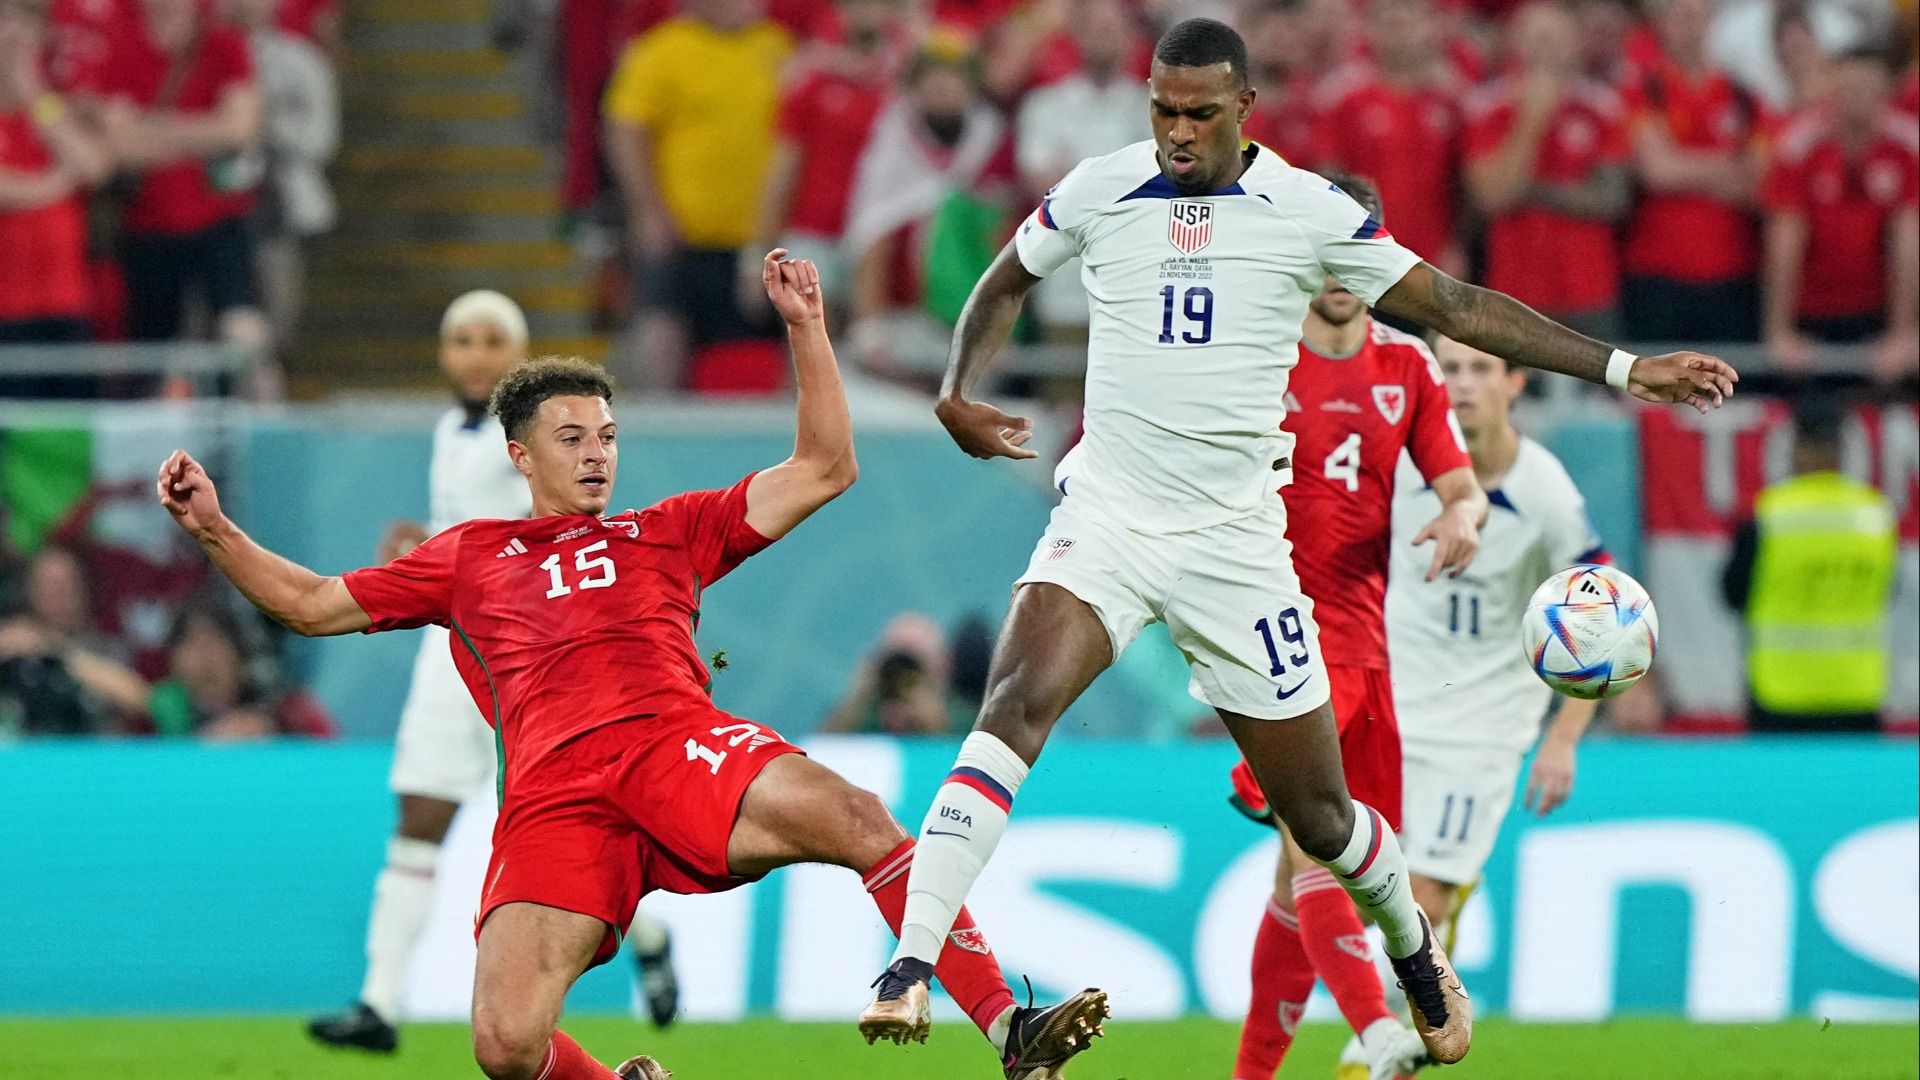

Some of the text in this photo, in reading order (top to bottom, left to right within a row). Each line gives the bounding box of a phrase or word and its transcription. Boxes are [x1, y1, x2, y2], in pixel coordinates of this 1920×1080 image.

[1173, 203, 1211, 226] USA
[1158, 285, 1214, 344] 19
[1324, 433, 1362, 492] 4
[1050, 539, 1073, 549] USA
[539, 540, 617, 600] 15
[1449, 593, 1480, 637] 11
[1254, 606, 1309, 678] 19
[940, 805, 973, 829] USA
[1437, 794, 1474, 843] 11
[1366, 872, 1396, 900] USA
